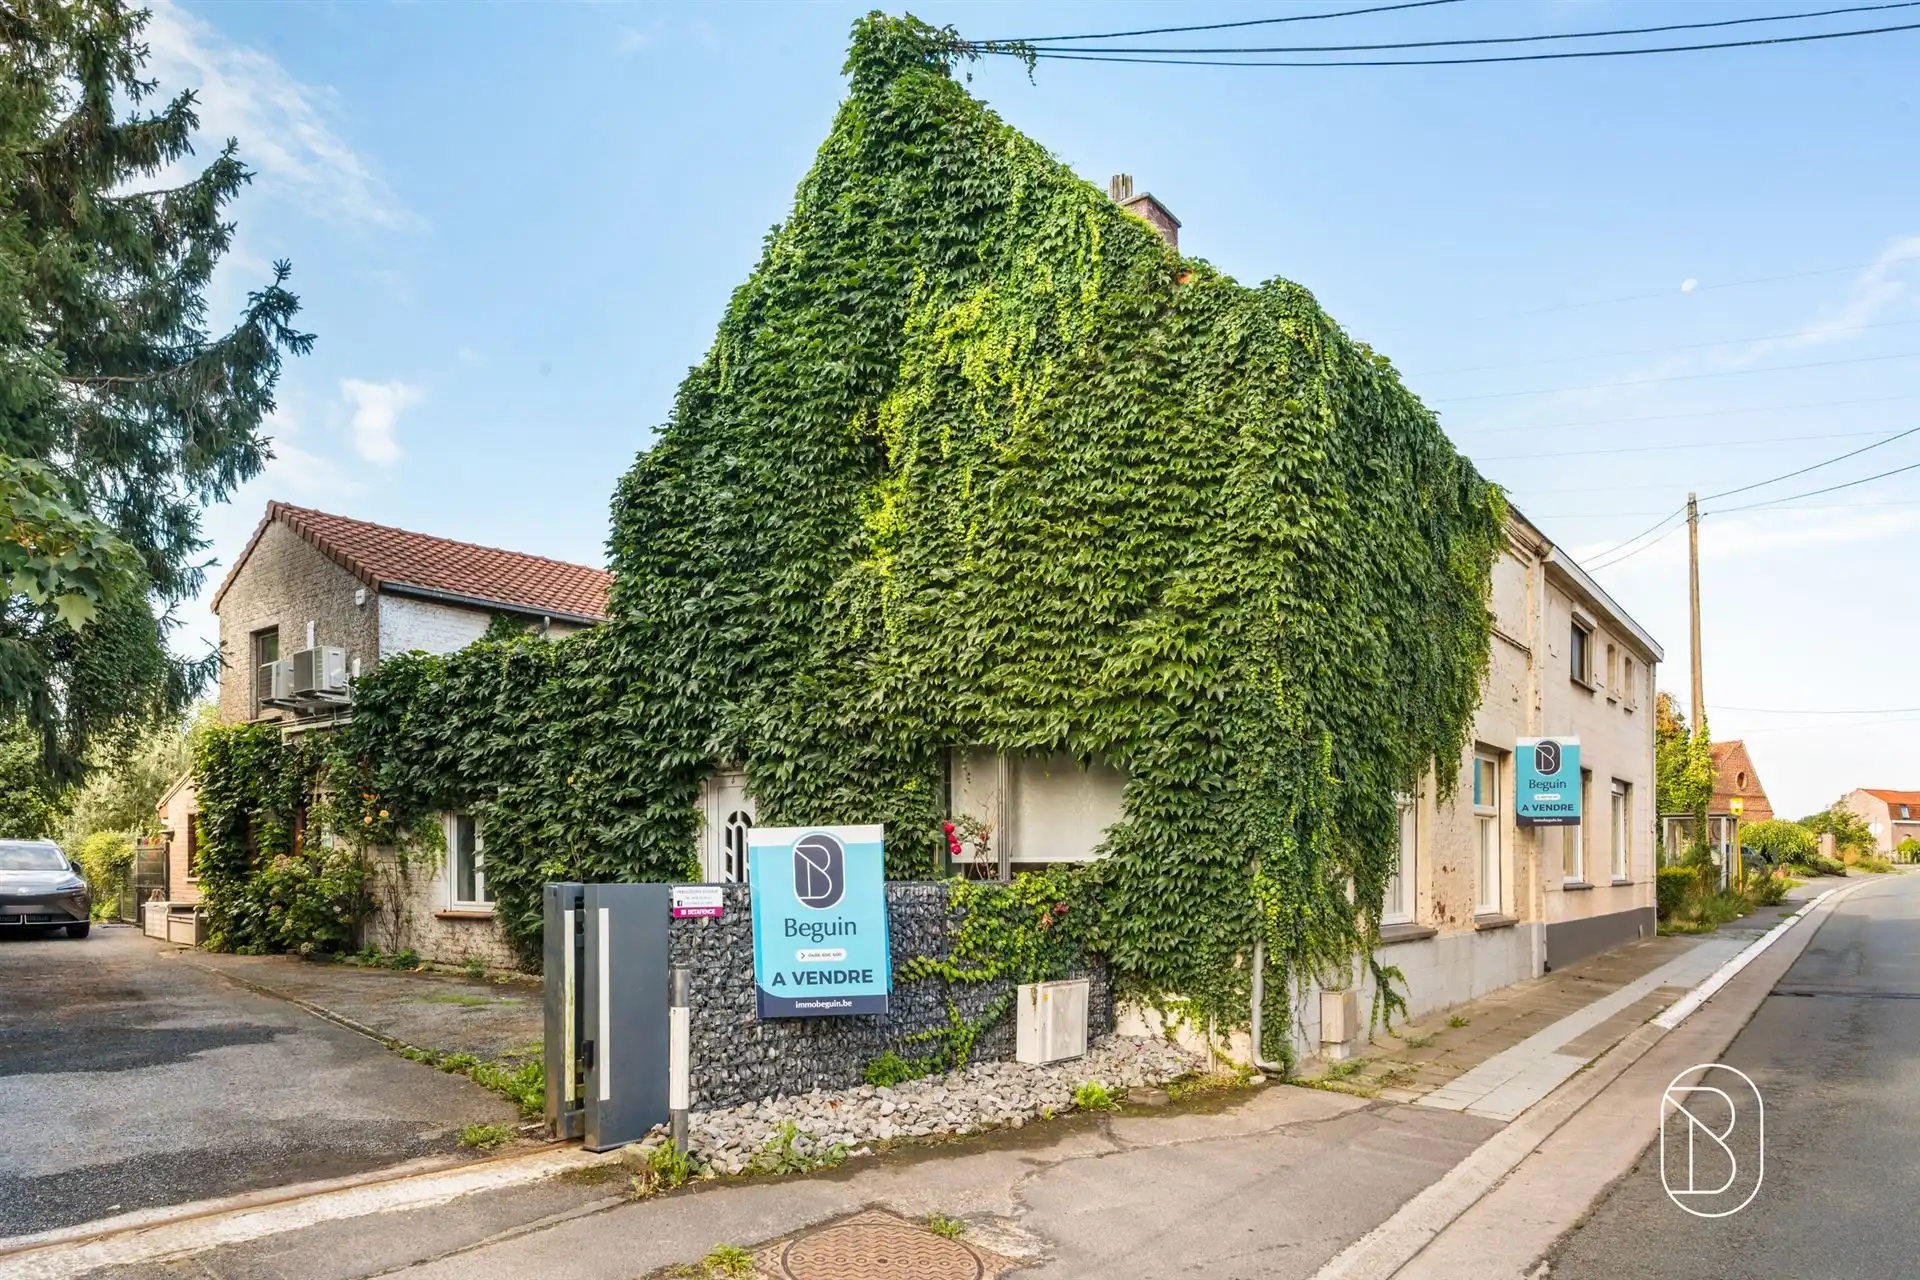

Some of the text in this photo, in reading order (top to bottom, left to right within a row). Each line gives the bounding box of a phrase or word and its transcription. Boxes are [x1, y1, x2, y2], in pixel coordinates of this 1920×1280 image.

[1529, 779, 1567, 791] Beguin
[1521, 803, 1574, 812] A VENDRE
[784, 916, 857, 944] Beguin
[771, 969, 874, 987] A VENDRE
[795, 999, 853, 1010] immobeguin.be
